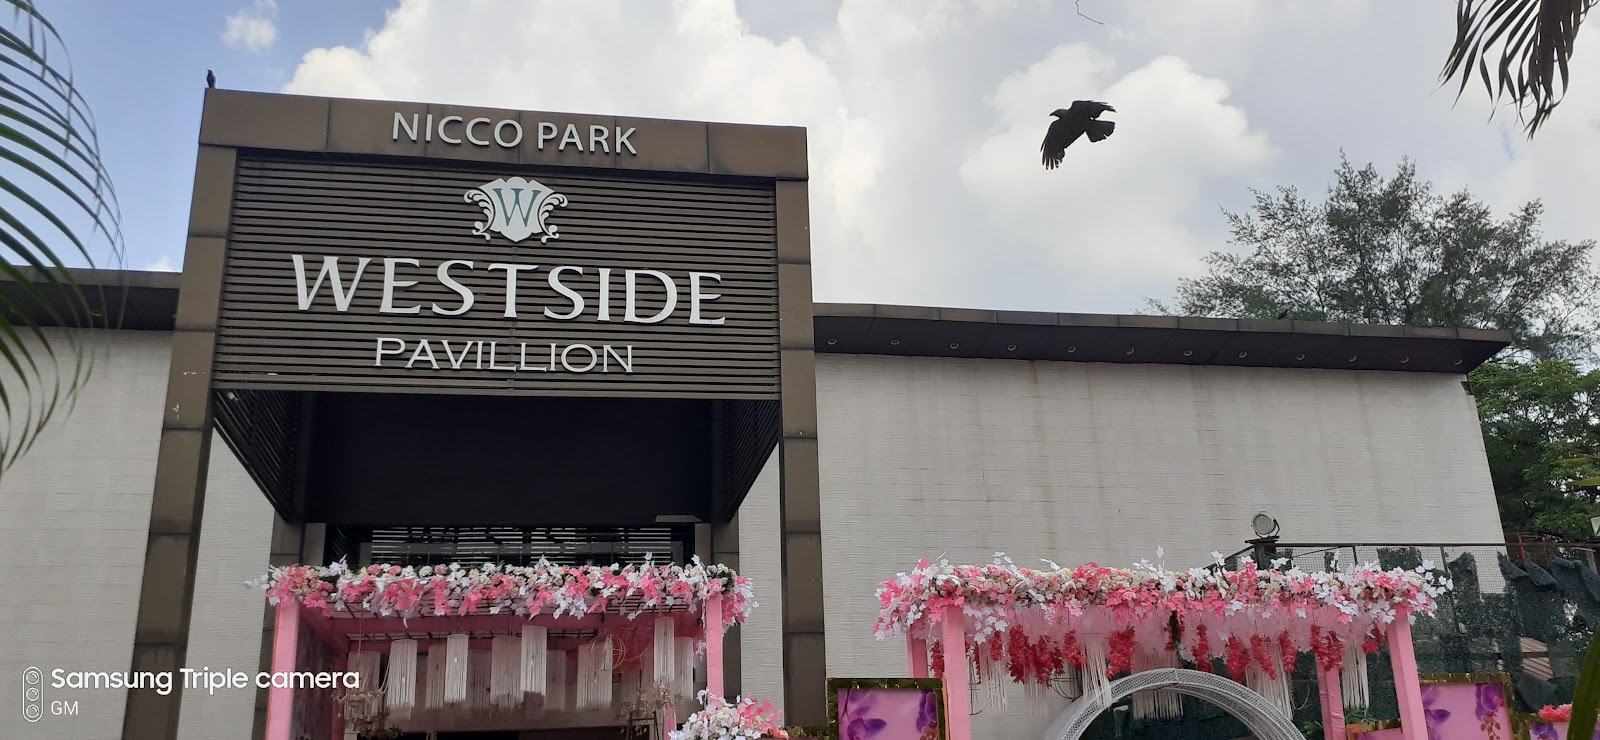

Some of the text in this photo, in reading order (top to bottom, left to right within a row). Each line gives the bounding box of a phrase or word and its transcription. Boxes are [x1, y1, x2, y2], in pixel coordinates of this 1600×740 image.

[392, 112, 638, 156] NICCO PARK
[491, 187, 542, 228] W
[291, 254, 727, 326] WESTSIDE
[374, 337, 635, 374] PAVILLION
